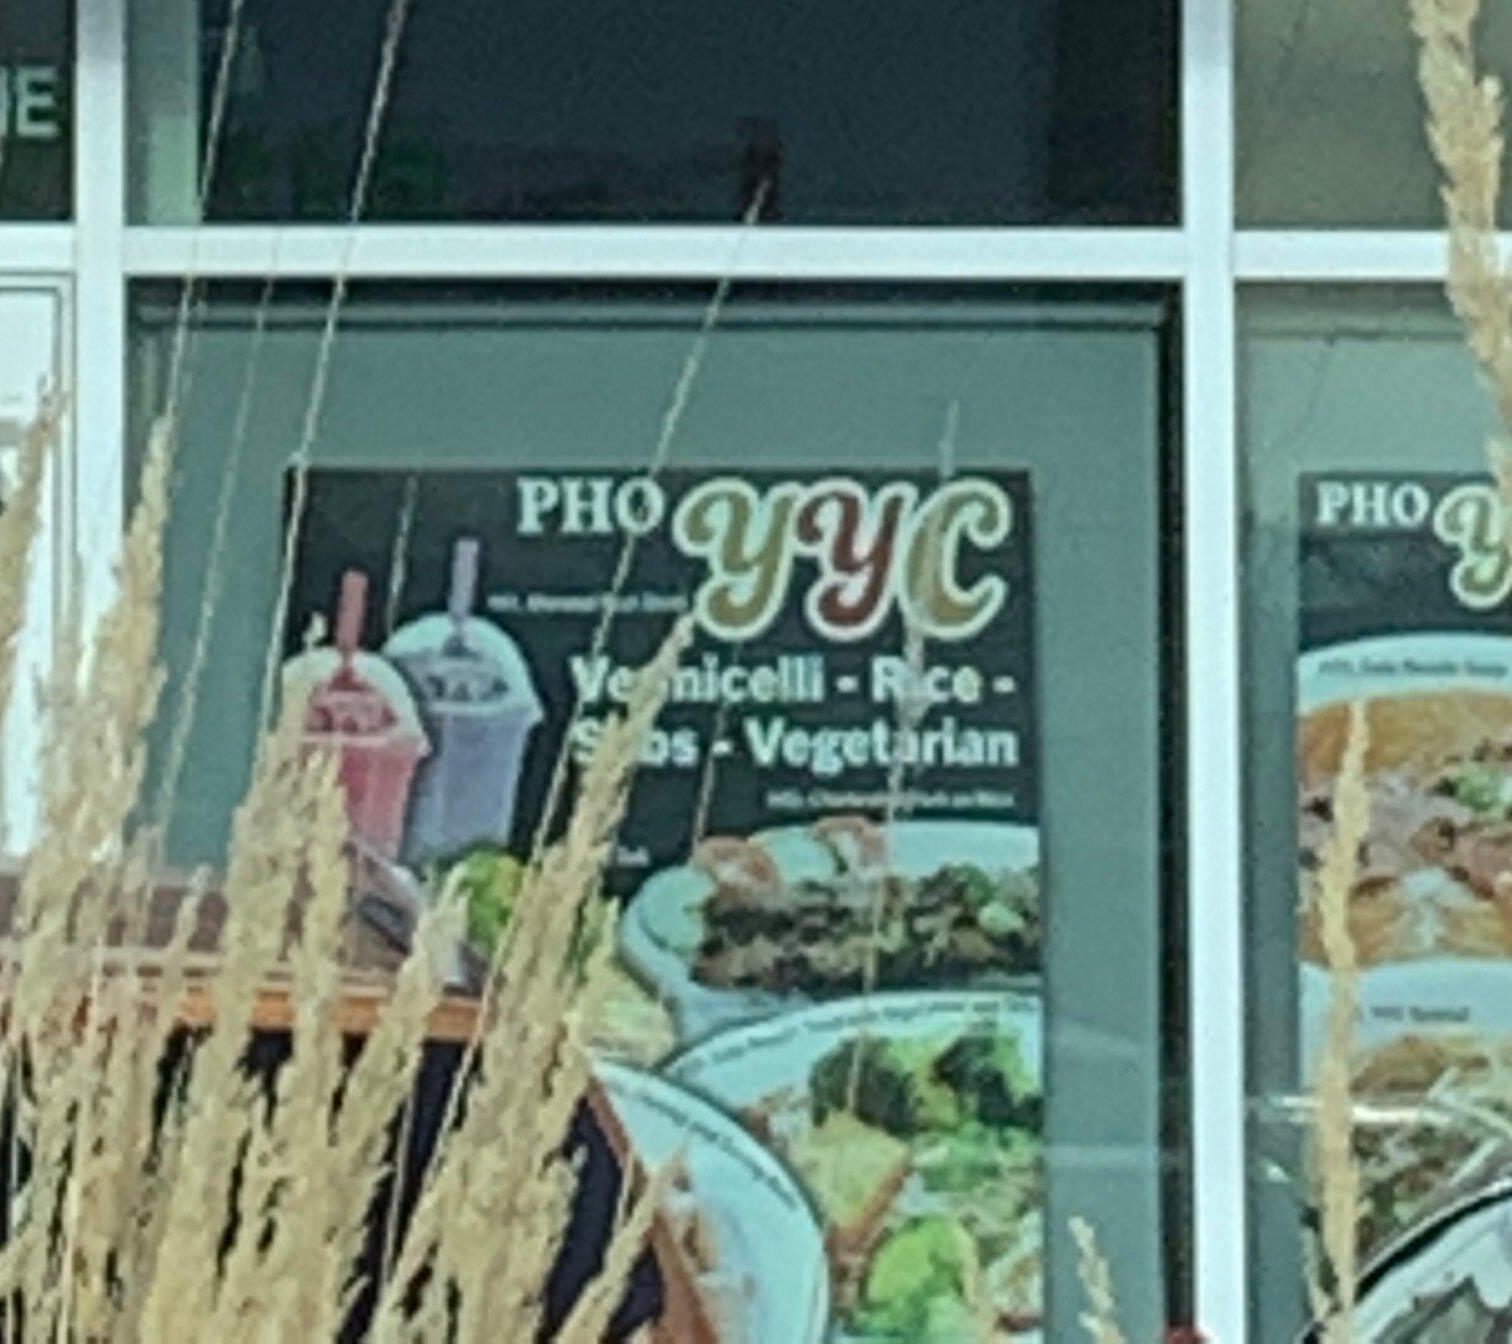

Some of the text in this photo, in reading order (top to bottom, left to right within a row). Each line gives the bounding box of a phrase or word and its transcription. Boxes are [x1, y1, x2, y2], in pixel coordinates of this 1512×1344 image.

[517, 477, 664, 535] PHO
[1315, 481, 1430, 528] PHO
[871, 656, 981, 703] Rce
